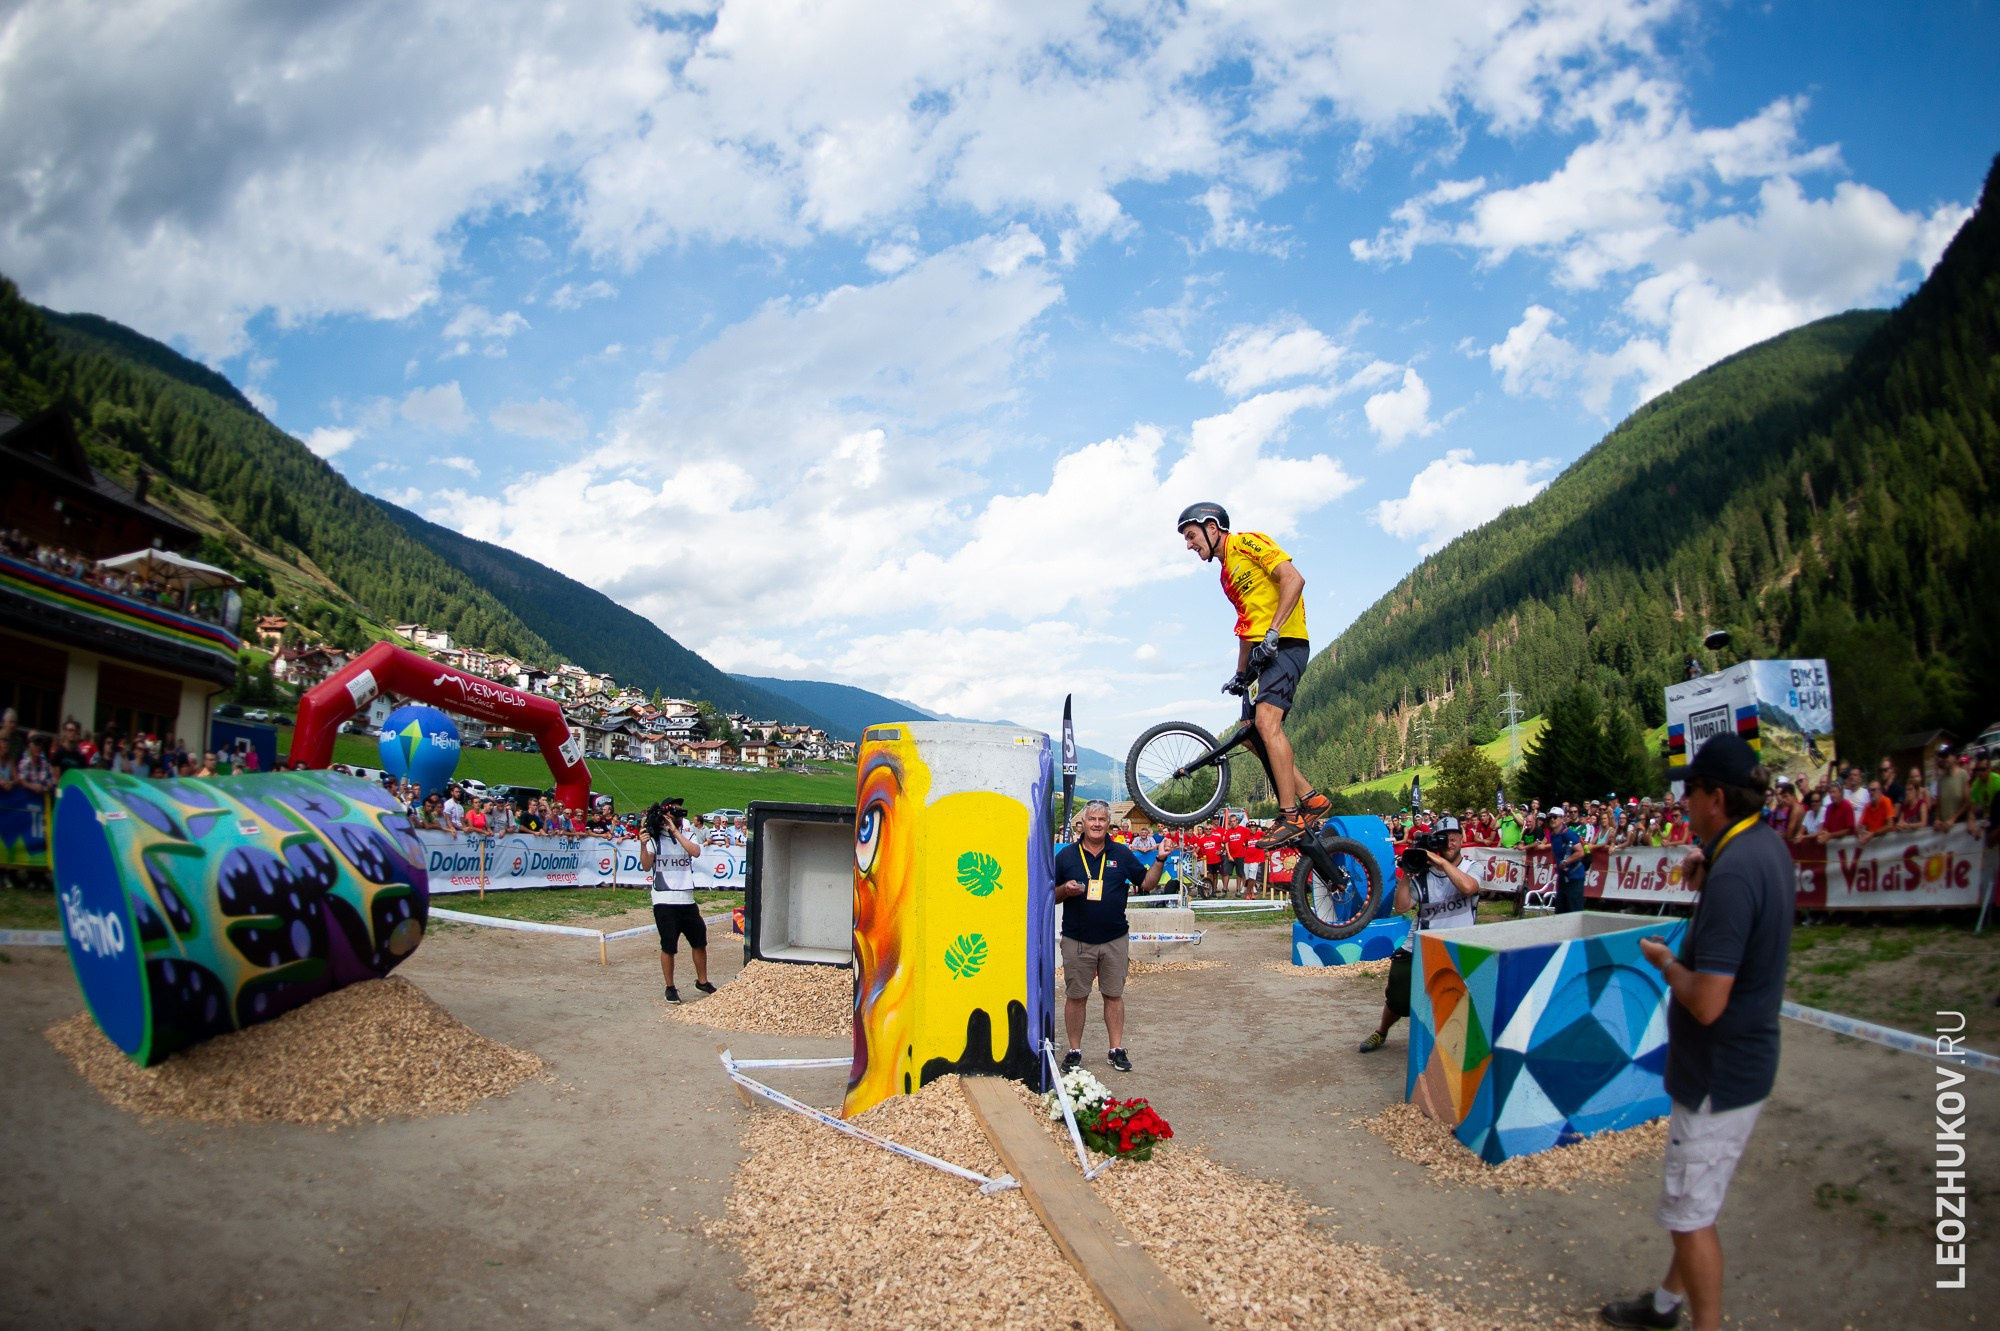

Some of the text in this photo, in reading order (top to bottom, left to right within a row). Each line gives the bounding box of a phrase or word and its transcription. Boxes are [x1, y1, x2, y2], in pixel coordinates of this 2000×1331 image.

[1790, 668, 1825, 688] BIKE
[461, 678, 526, 707] VERMIGLIO
[1798, 690, 1828, 710] FUN
[1693, 718, 1727, 740] WORLD
[1064, 728, 1075, 758] 5
[1413, 788, 1419, 800] 4
[1497, 793, 1503, 804] 3
[531, 853, 579, 870] Dolomiti
[657, 858, 668, 867] TV
[1838, 845, 1972, 894] Val di Sole
[546, 873, 577, 883] energia
[1615, 856, 1641, 891] Val
[1641, 871, 1655, 890] di
[1439, 896, 1468, 913] HOST
